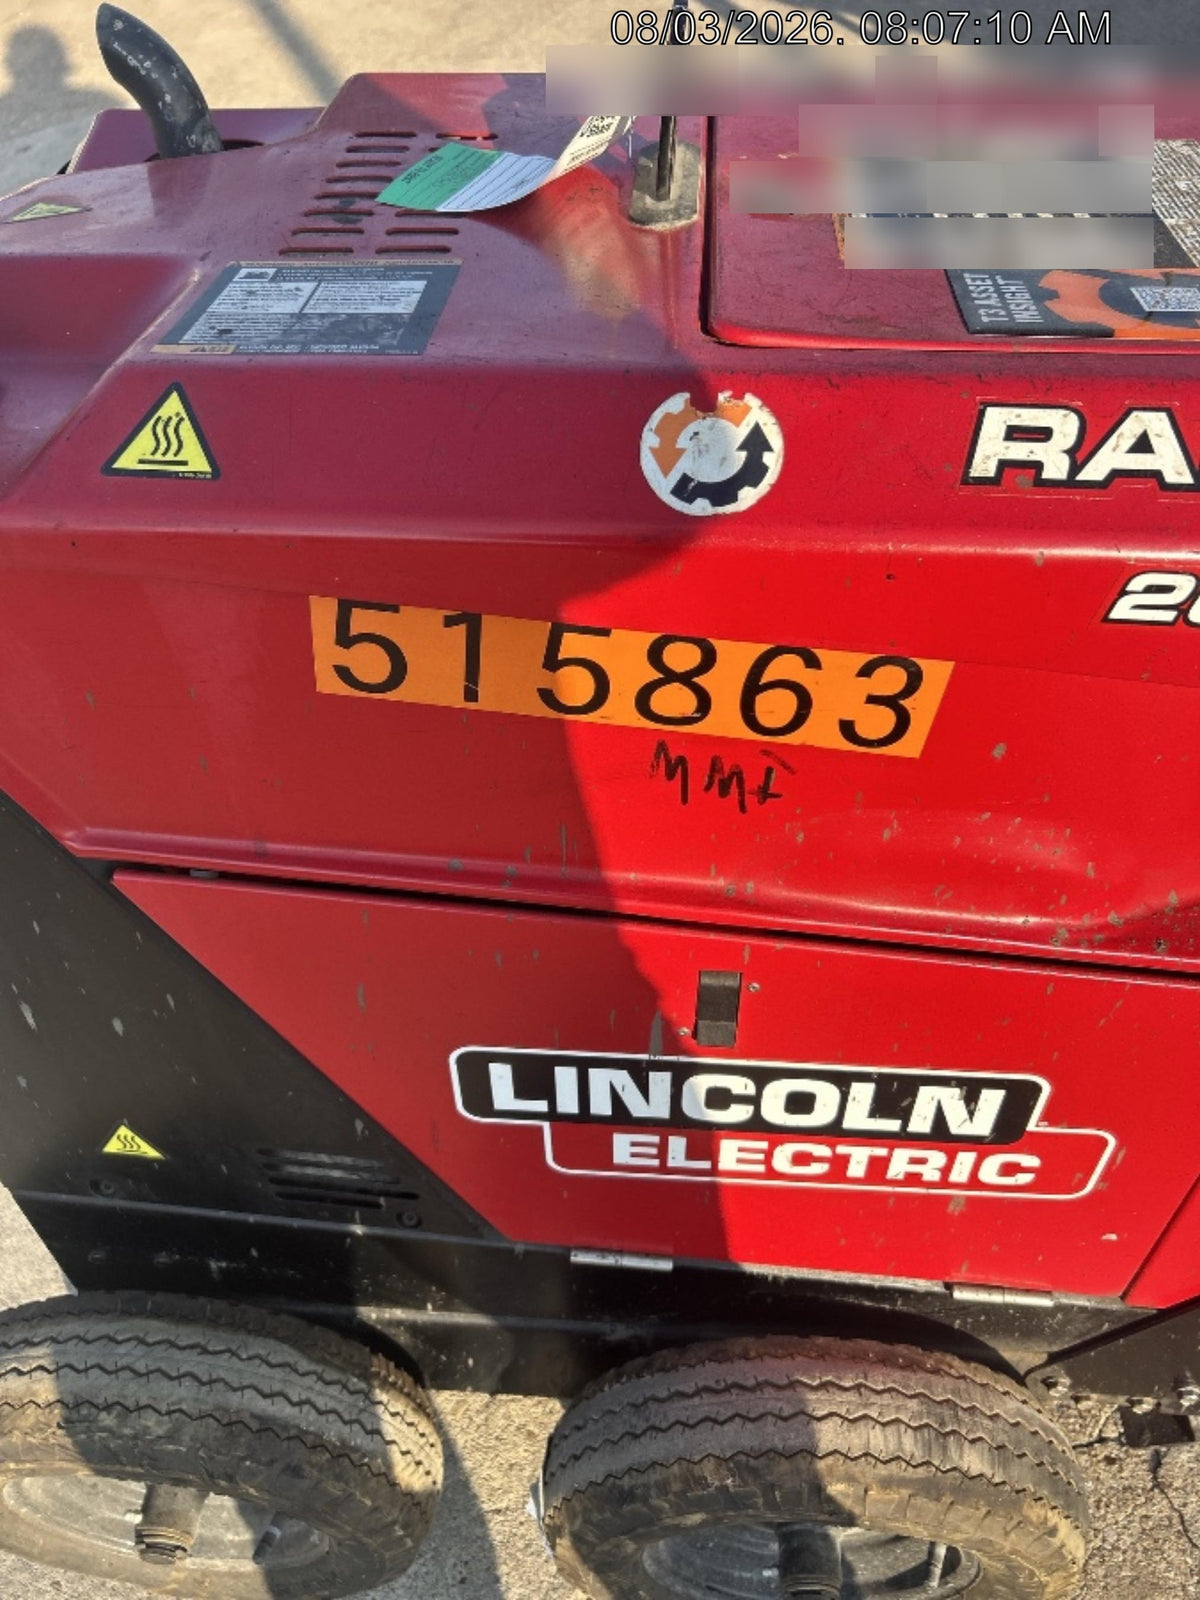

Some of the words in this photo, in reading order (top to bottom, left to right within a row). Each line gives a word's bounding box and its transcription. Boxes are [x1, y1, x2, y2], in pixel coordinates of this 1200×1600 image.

[963, 273, 1001, 306] ASSET
[980, 308, 1009, 323] T3
[995, 275, 1044, 323] INSIGHT
[1103, 571, 1200, 625] 2
[331, 598, 925, 750] 515863
[487, 1062, 1008, 1136] LINCOLN
[611, 1132, 1042, 1187] ELECTRIC
